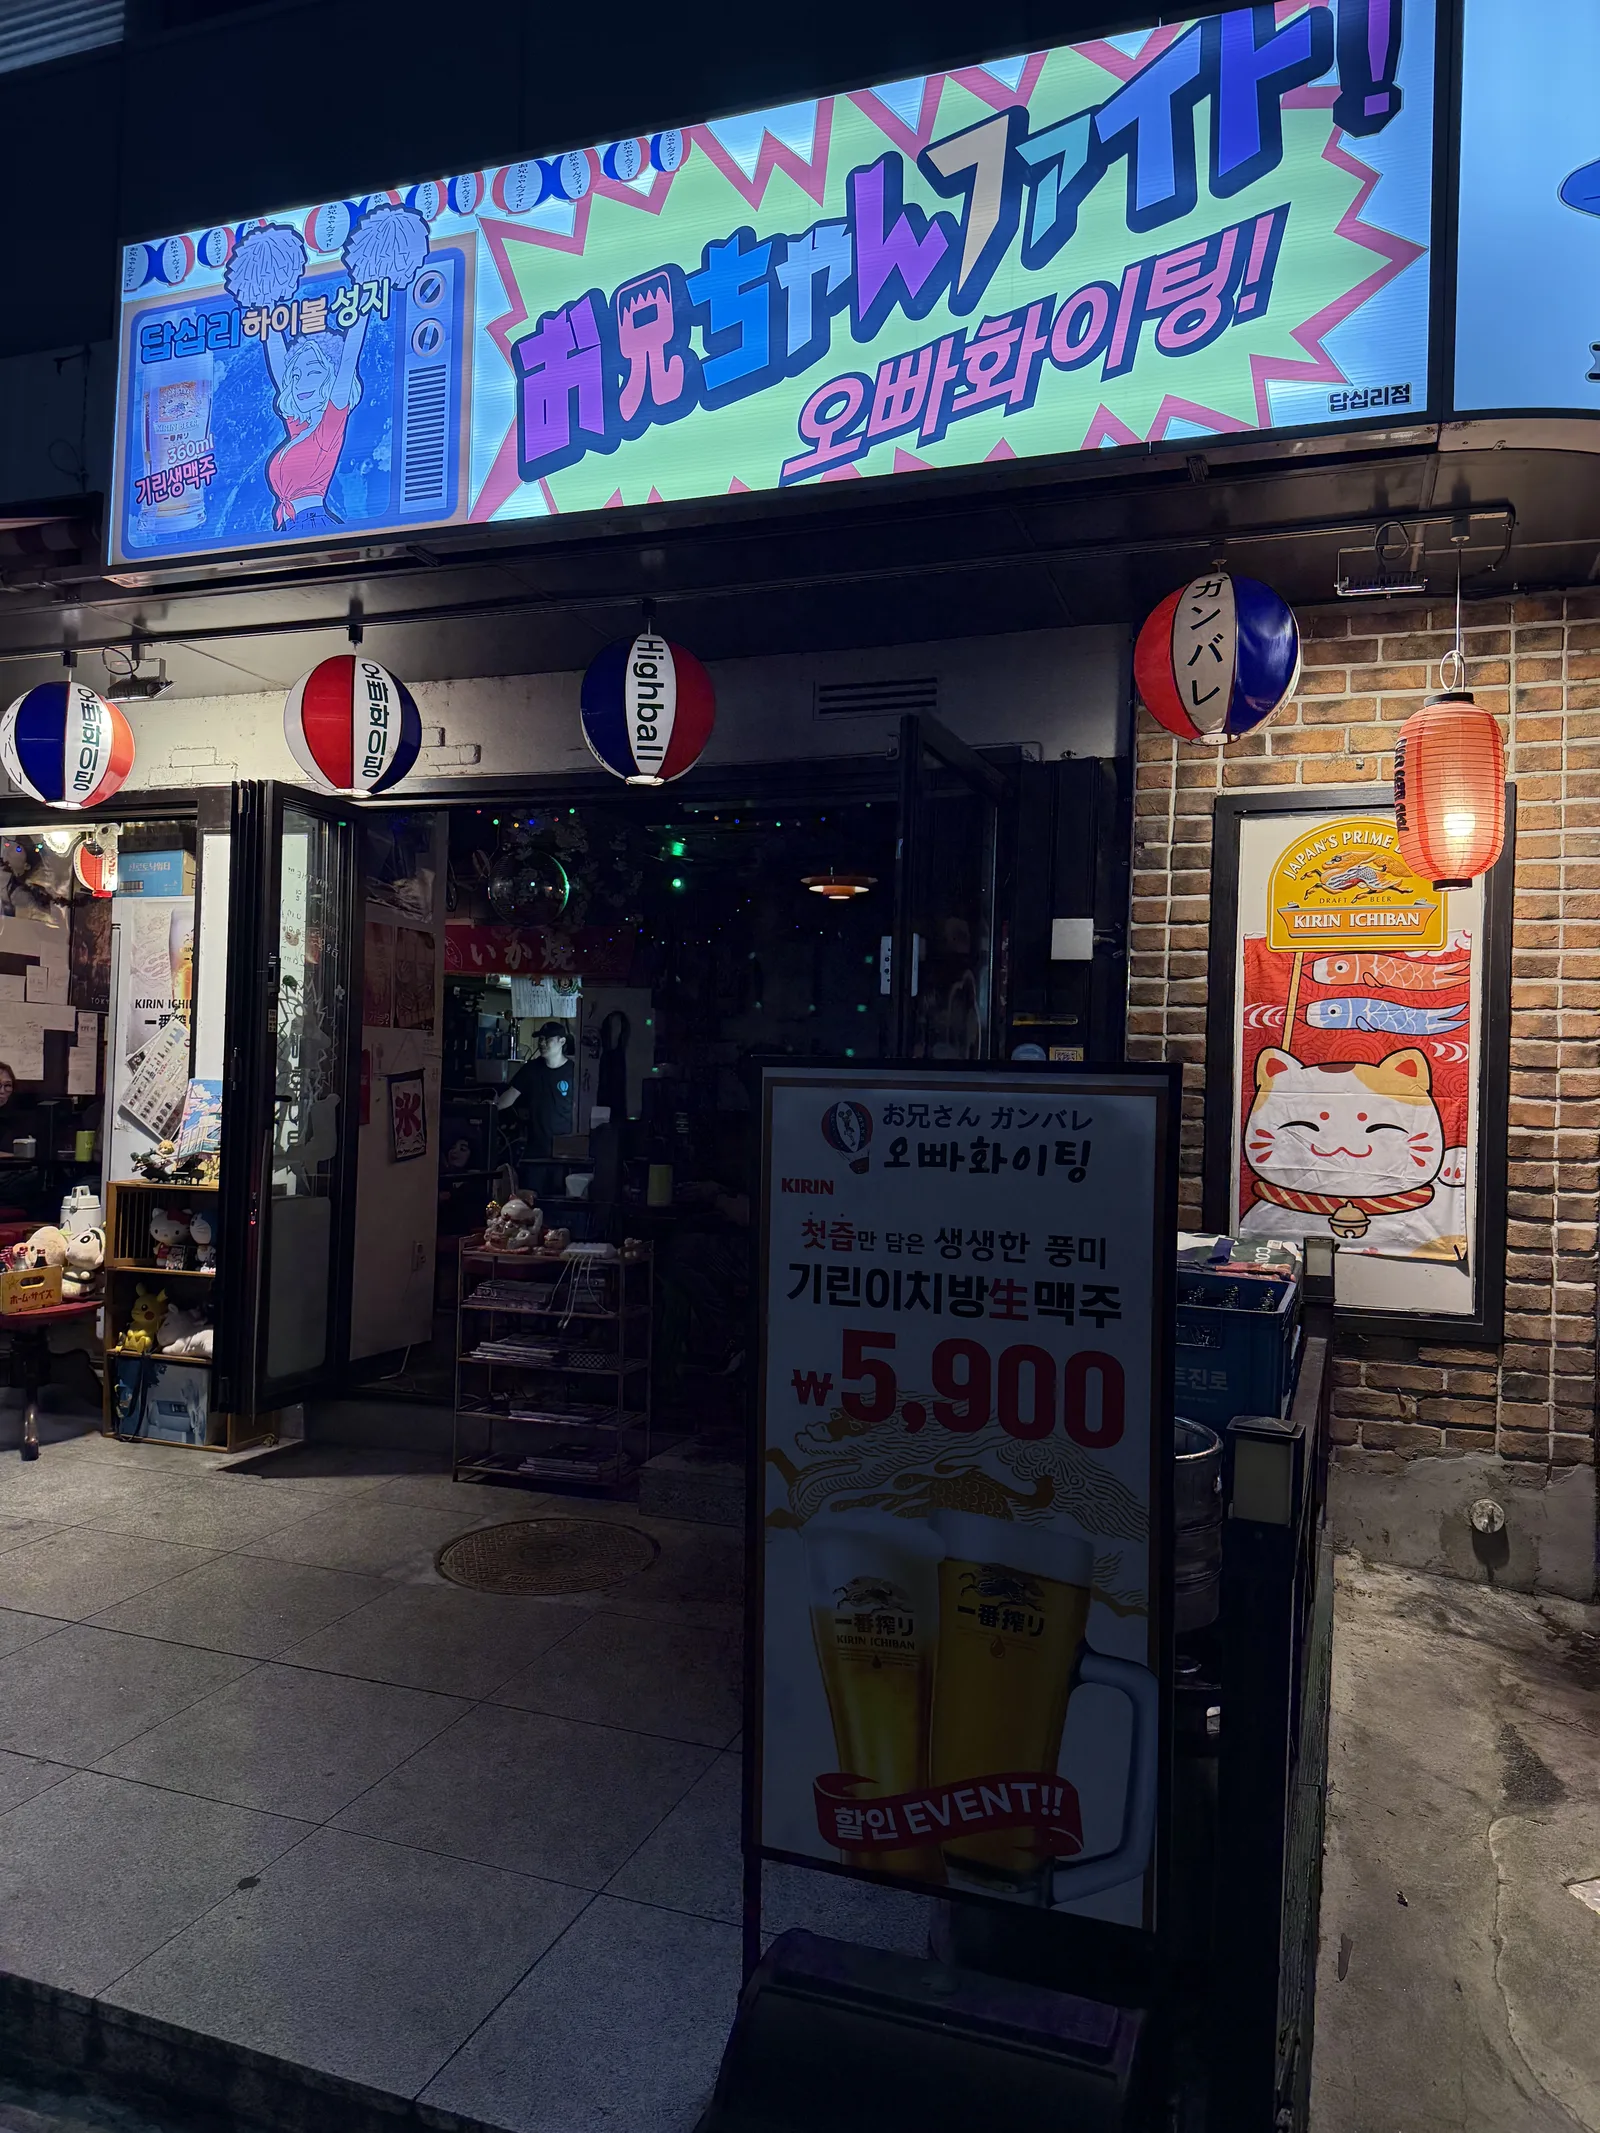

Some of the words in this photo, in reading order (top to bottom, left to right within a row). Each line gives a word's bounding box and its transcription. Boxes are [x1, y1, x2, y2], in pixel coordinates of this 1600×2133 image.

[140, 309, 241, 364] 답십리
[242, 297, 327, 341] 하이볼
[331, 277, 390, 327] 성지
[780, 208, 1282, 482] 오빠화이팅!
[1329, 384, 1411, 413] 답십리점
[167, 432, 215, 465] 360ml
[135, 454, 218, 505] 기린생맥주
[1186, 577, 1230, 707] ガンバレ
[361, 662, 390, 779] 오빠화이팅
[633, 639, 664, 762] Highball
[73, 686, 103, 792] 오빠화이팅
[1282, 833, 1339, 880] JAPAN'S
[1342, 829, 1393, 849] PRIME
[1293, 913, 1341, 928] KIRIN
[1349, 912, 1420, 927] ICHIBAN
[1319, 896, 1348, 905] DRAFT
[1369, 895, 1393, 904] BEER
[135, 998, 164, 1009] KIRIN
[882, 1102, 981, 1130] お兄さん
[990, 1105, 1094, 1132] ガンバレ
[883, 1135, 1092, 1184] 오빠화이팅
[781, 1177, 834, 1196] KIRIN
[801, 1216, 878, 1253] 첫즙만
[886, 1230, 926, 1256] 담은
[934, 1227, 1031, 1265] 생생한
[1044, 1233, 1107, 1270] 풍미
[786, 1262, 1123, 1329] 기린이치방生맥주
[834, 1612, 914, 1637] 一番搾り
[836, 1633, 866, 1647] KIRIN
[870, 1635, 915, 1651] ICHIBAN
[956, 1602, 1045, 1637] 一番搾り
[833, 1806, 899, 1841] 할인
[902, 1781, 1064, 1836] EVENT!!
